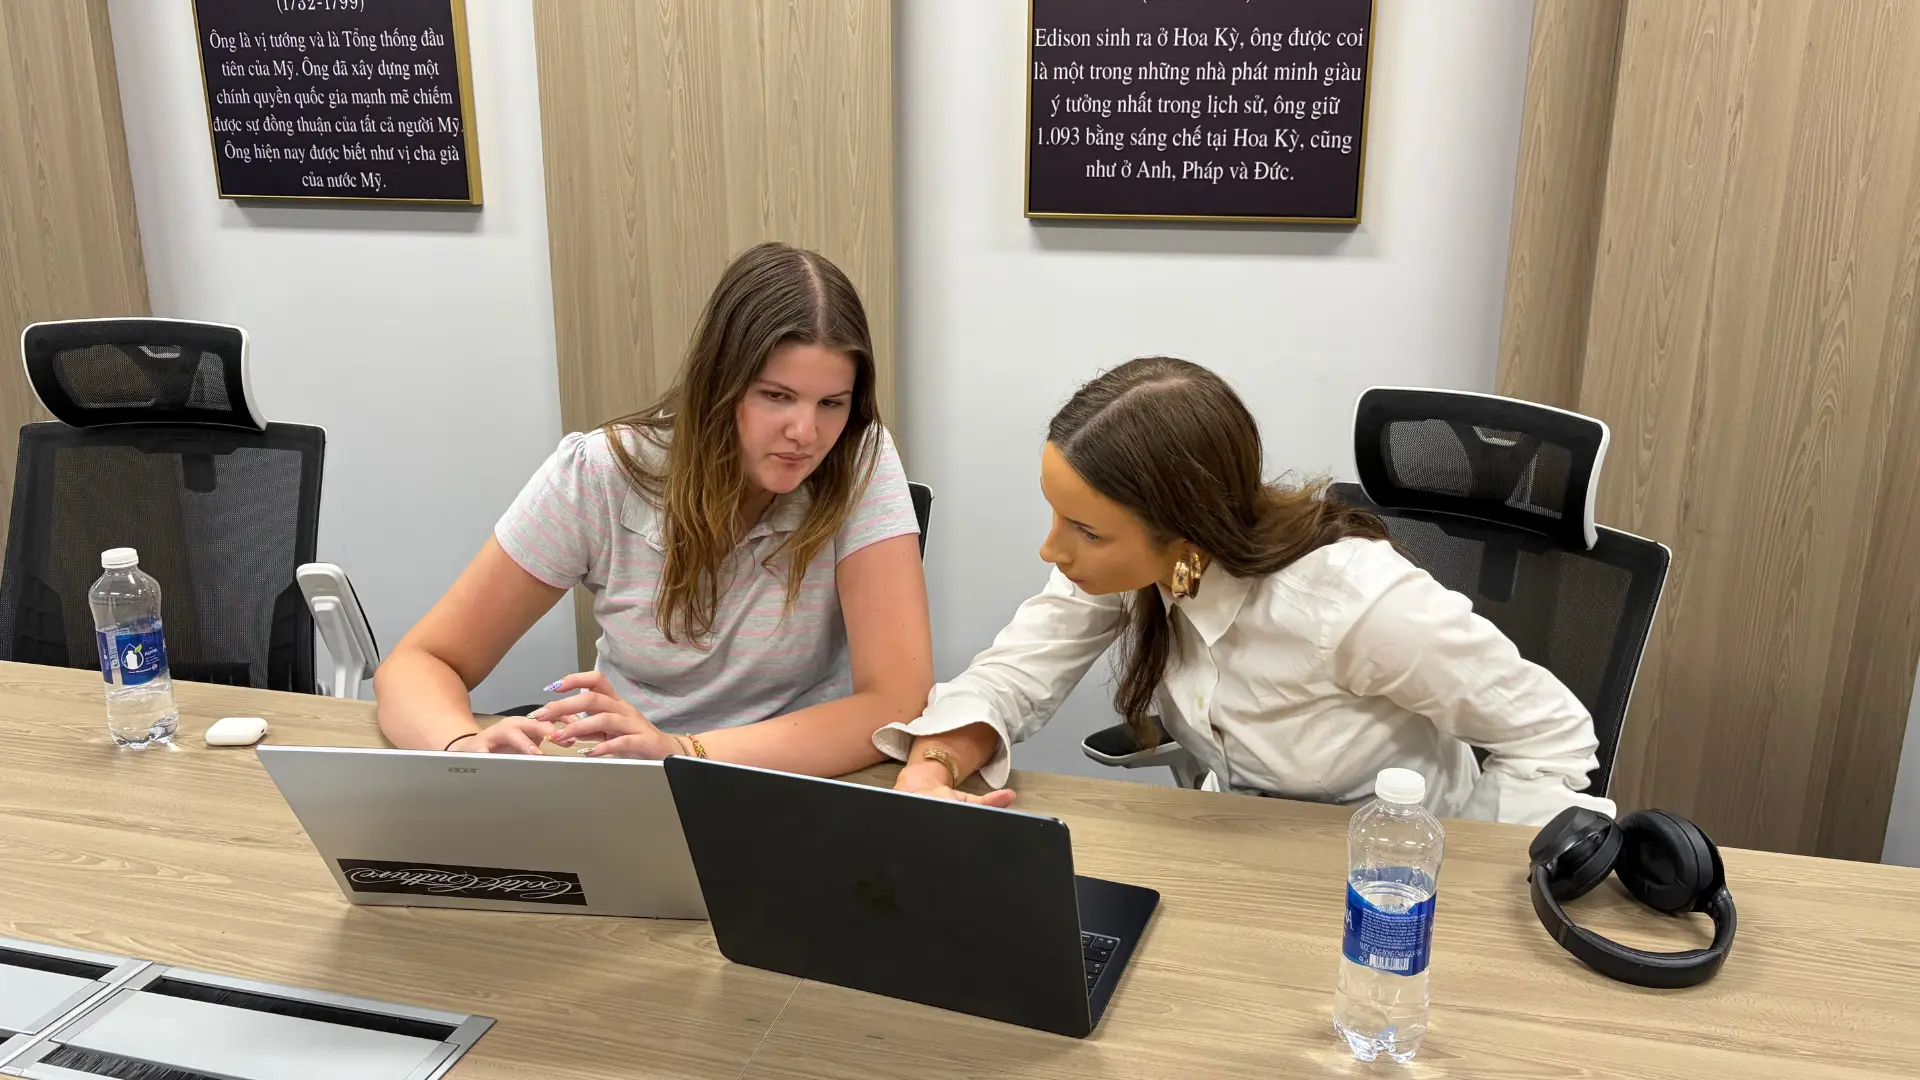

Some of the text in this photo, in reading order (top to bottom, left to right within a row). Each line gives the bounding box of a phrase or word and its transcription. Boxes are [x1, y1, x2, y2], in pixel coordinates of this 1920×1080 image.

[210, 28, 444, 52] Ông là vị tướng và là Tổng thống đầu
[1035, 27, 1363, 51] Edison sinh ra ở Hoa Kỳ, ông được coi
[222, 56, 439, 80] tiên của Mỹ. Ông đã xây dựng một
[1034, 61, 1361, 86] là một trong những nhà phát minh giàu
[217, 86, 452, 108] chính quyền quốc gia mạnh mẽ chiếm
[1051, 91, 1340, 119] ý tưởng nhất trong lịch sử, ông giữ
[213, 114, 463, 137] được sự đồng thuận của tất cả người Mỹ.
[1039, 124, 1352, 154] 1.093 bằng sáng chế tại Hoa Kỳ, cũng
[225, 140, 459, 165] Ông hiện nay được biết như vị cha già
[302, 172, 386, 191] của nước Mỹ.
[1086, 160, 1293, 184] như ở Anh, Pháp và Đức.
